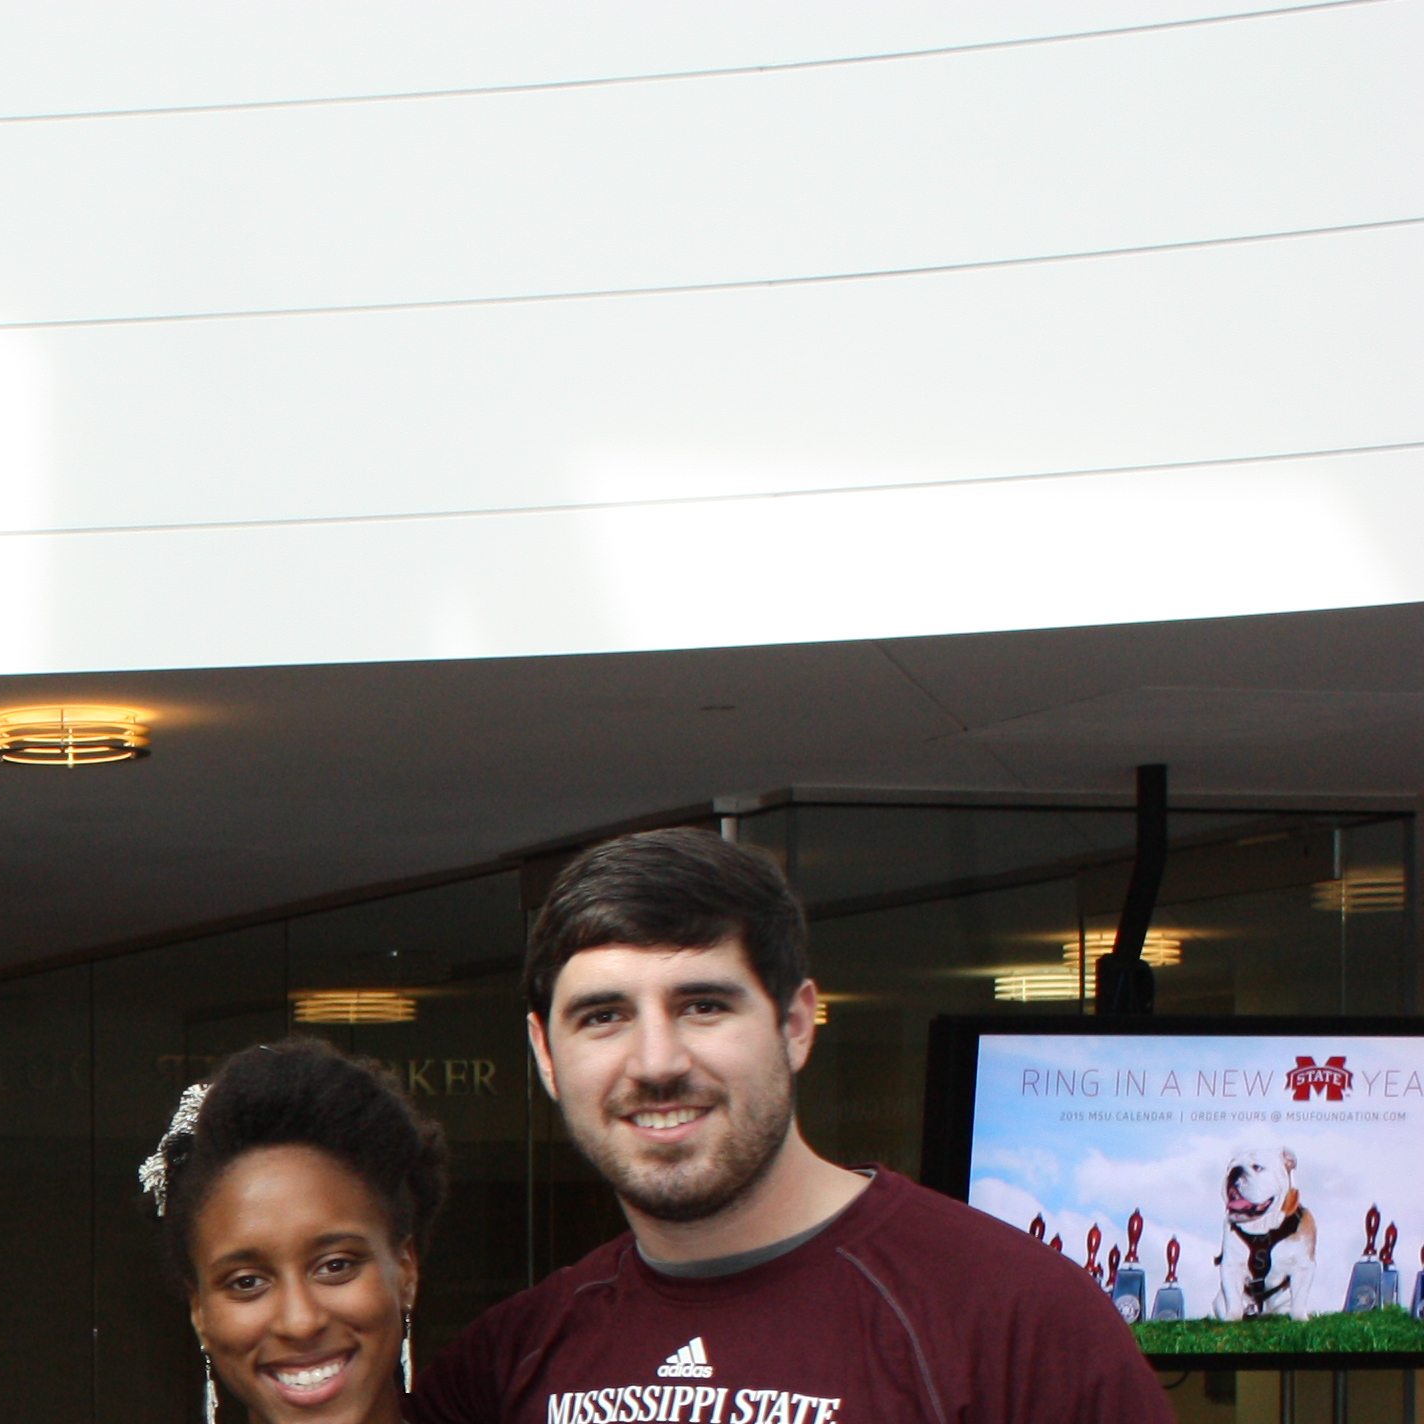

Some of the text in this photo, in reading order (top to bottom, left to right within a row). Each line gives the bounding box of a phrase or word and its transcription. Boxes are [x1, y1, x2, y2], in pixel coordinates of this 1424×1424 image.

[1022, 1068, 1274, 1098] RING IN A NEW
[1296, 1069, 1342, 1087] STATE
[1059, 1111, 1084, 1122] 2015
[1088, 1111, 1113, 1122] MSU
[1116, 1111, 1173, 1122] CALENDAR
[1190, 1111, 1226, 1122] ORDER
[1232, 1111, 1266, 1122] YOURS
[1286, 1111, 1406, 1122] MSUFOUNDATION.COM
[656, 1362, 714, 1379] adidas
